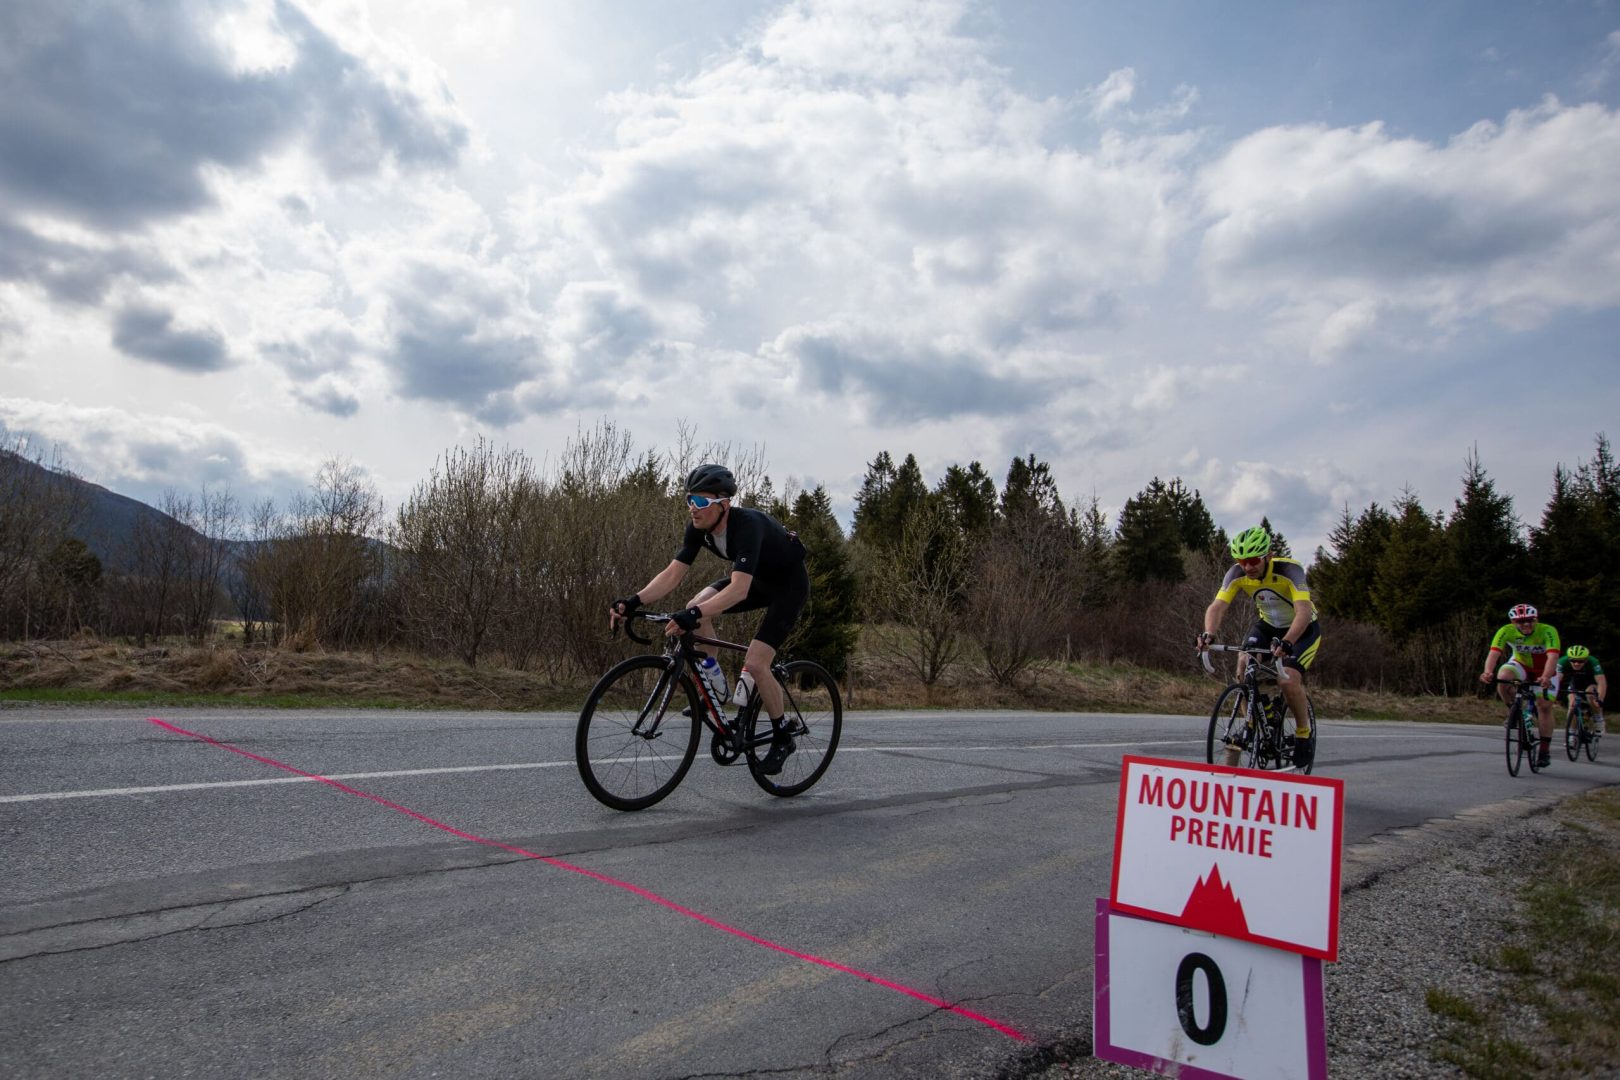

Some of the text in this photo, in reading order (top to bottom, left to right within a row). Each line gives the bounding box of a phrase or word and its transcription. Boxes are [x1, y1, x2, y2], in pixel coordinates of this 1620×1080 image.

[1138, 774, 1318, 830] MOUNTAIN
[1170, 815, 1273, 858] PREMIE
[1175, 952, 1228, 1046] 0
